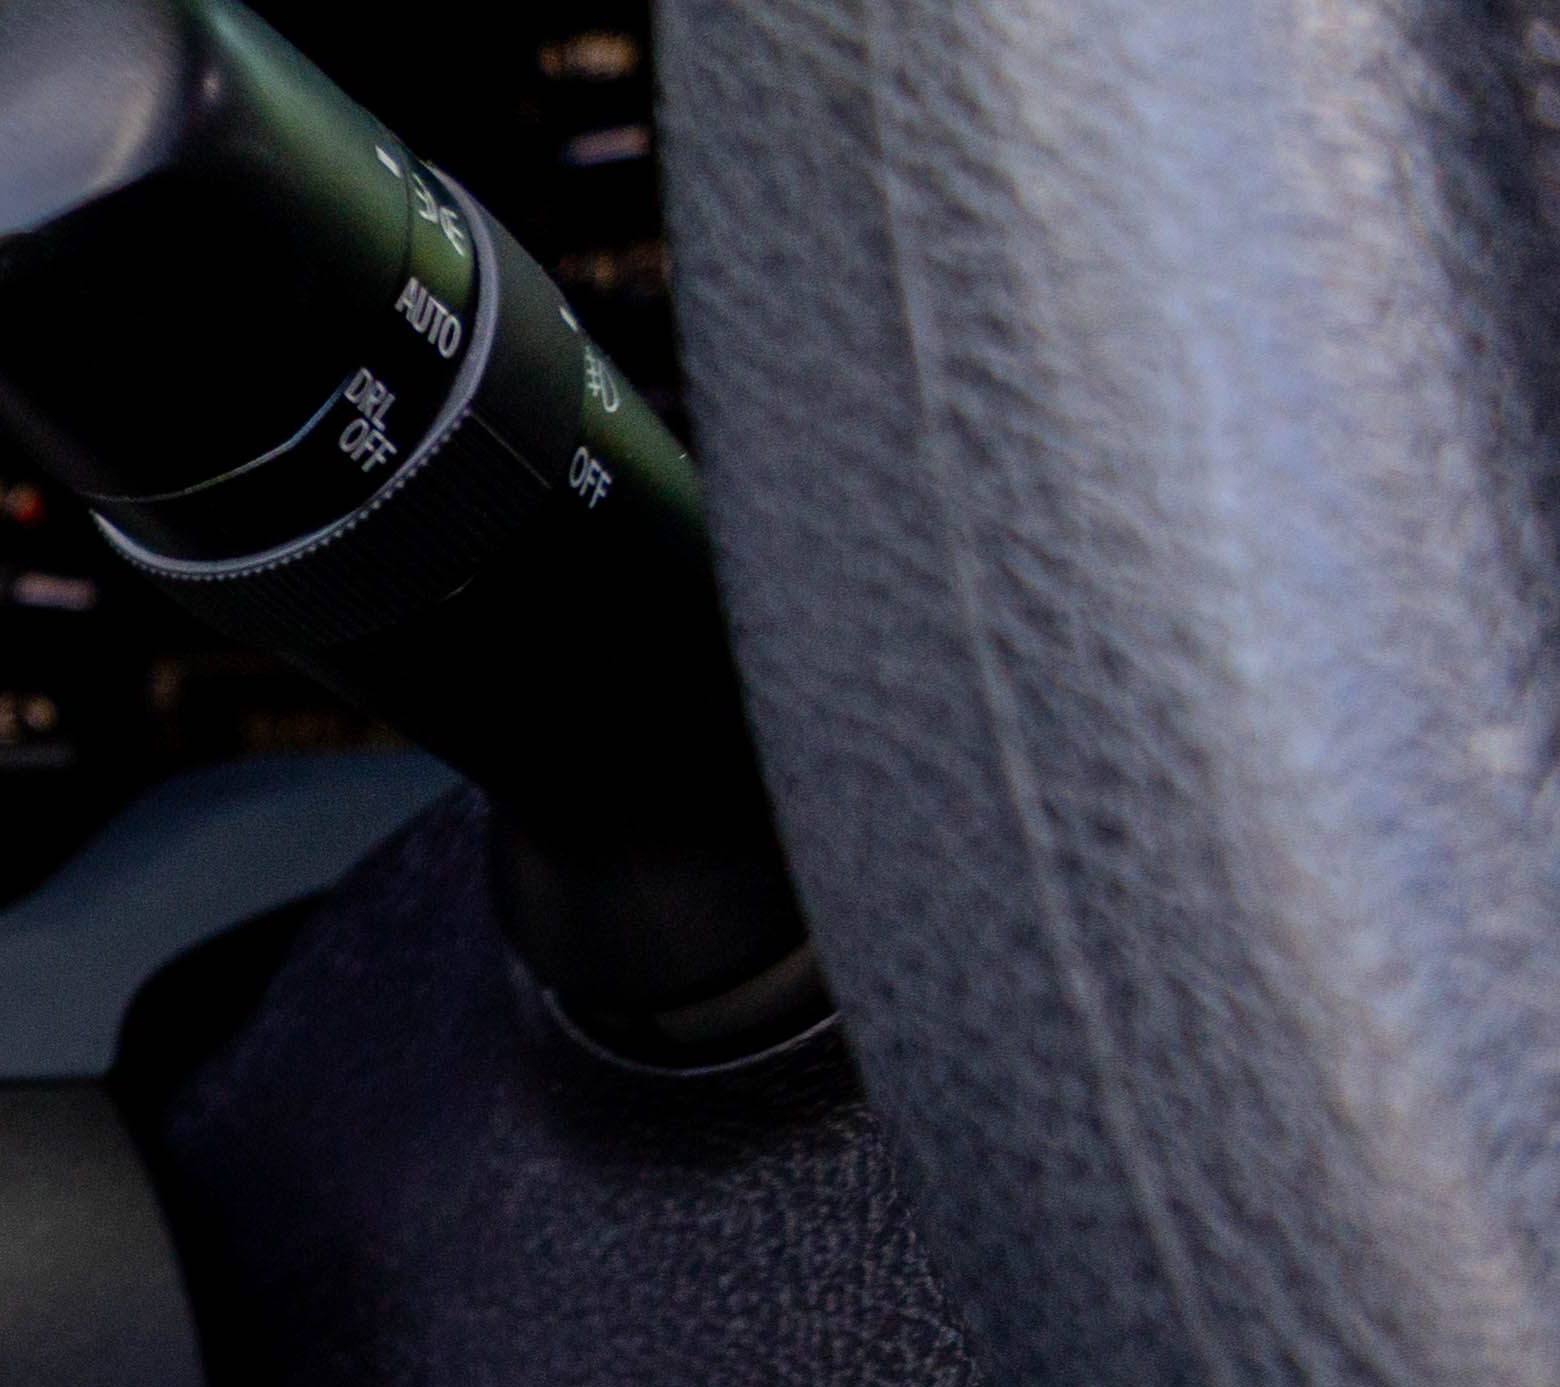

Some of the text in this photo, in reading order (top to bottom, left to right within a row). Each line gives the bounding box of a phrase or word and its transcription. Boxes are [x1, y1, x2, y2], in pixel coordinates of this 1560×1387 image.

[394, 277, 462, 358] AUTO
[344, 367, 396, 430] DRL
[339, 418, 397, 472] OFF
[568, 446, 613, 508] OFF
